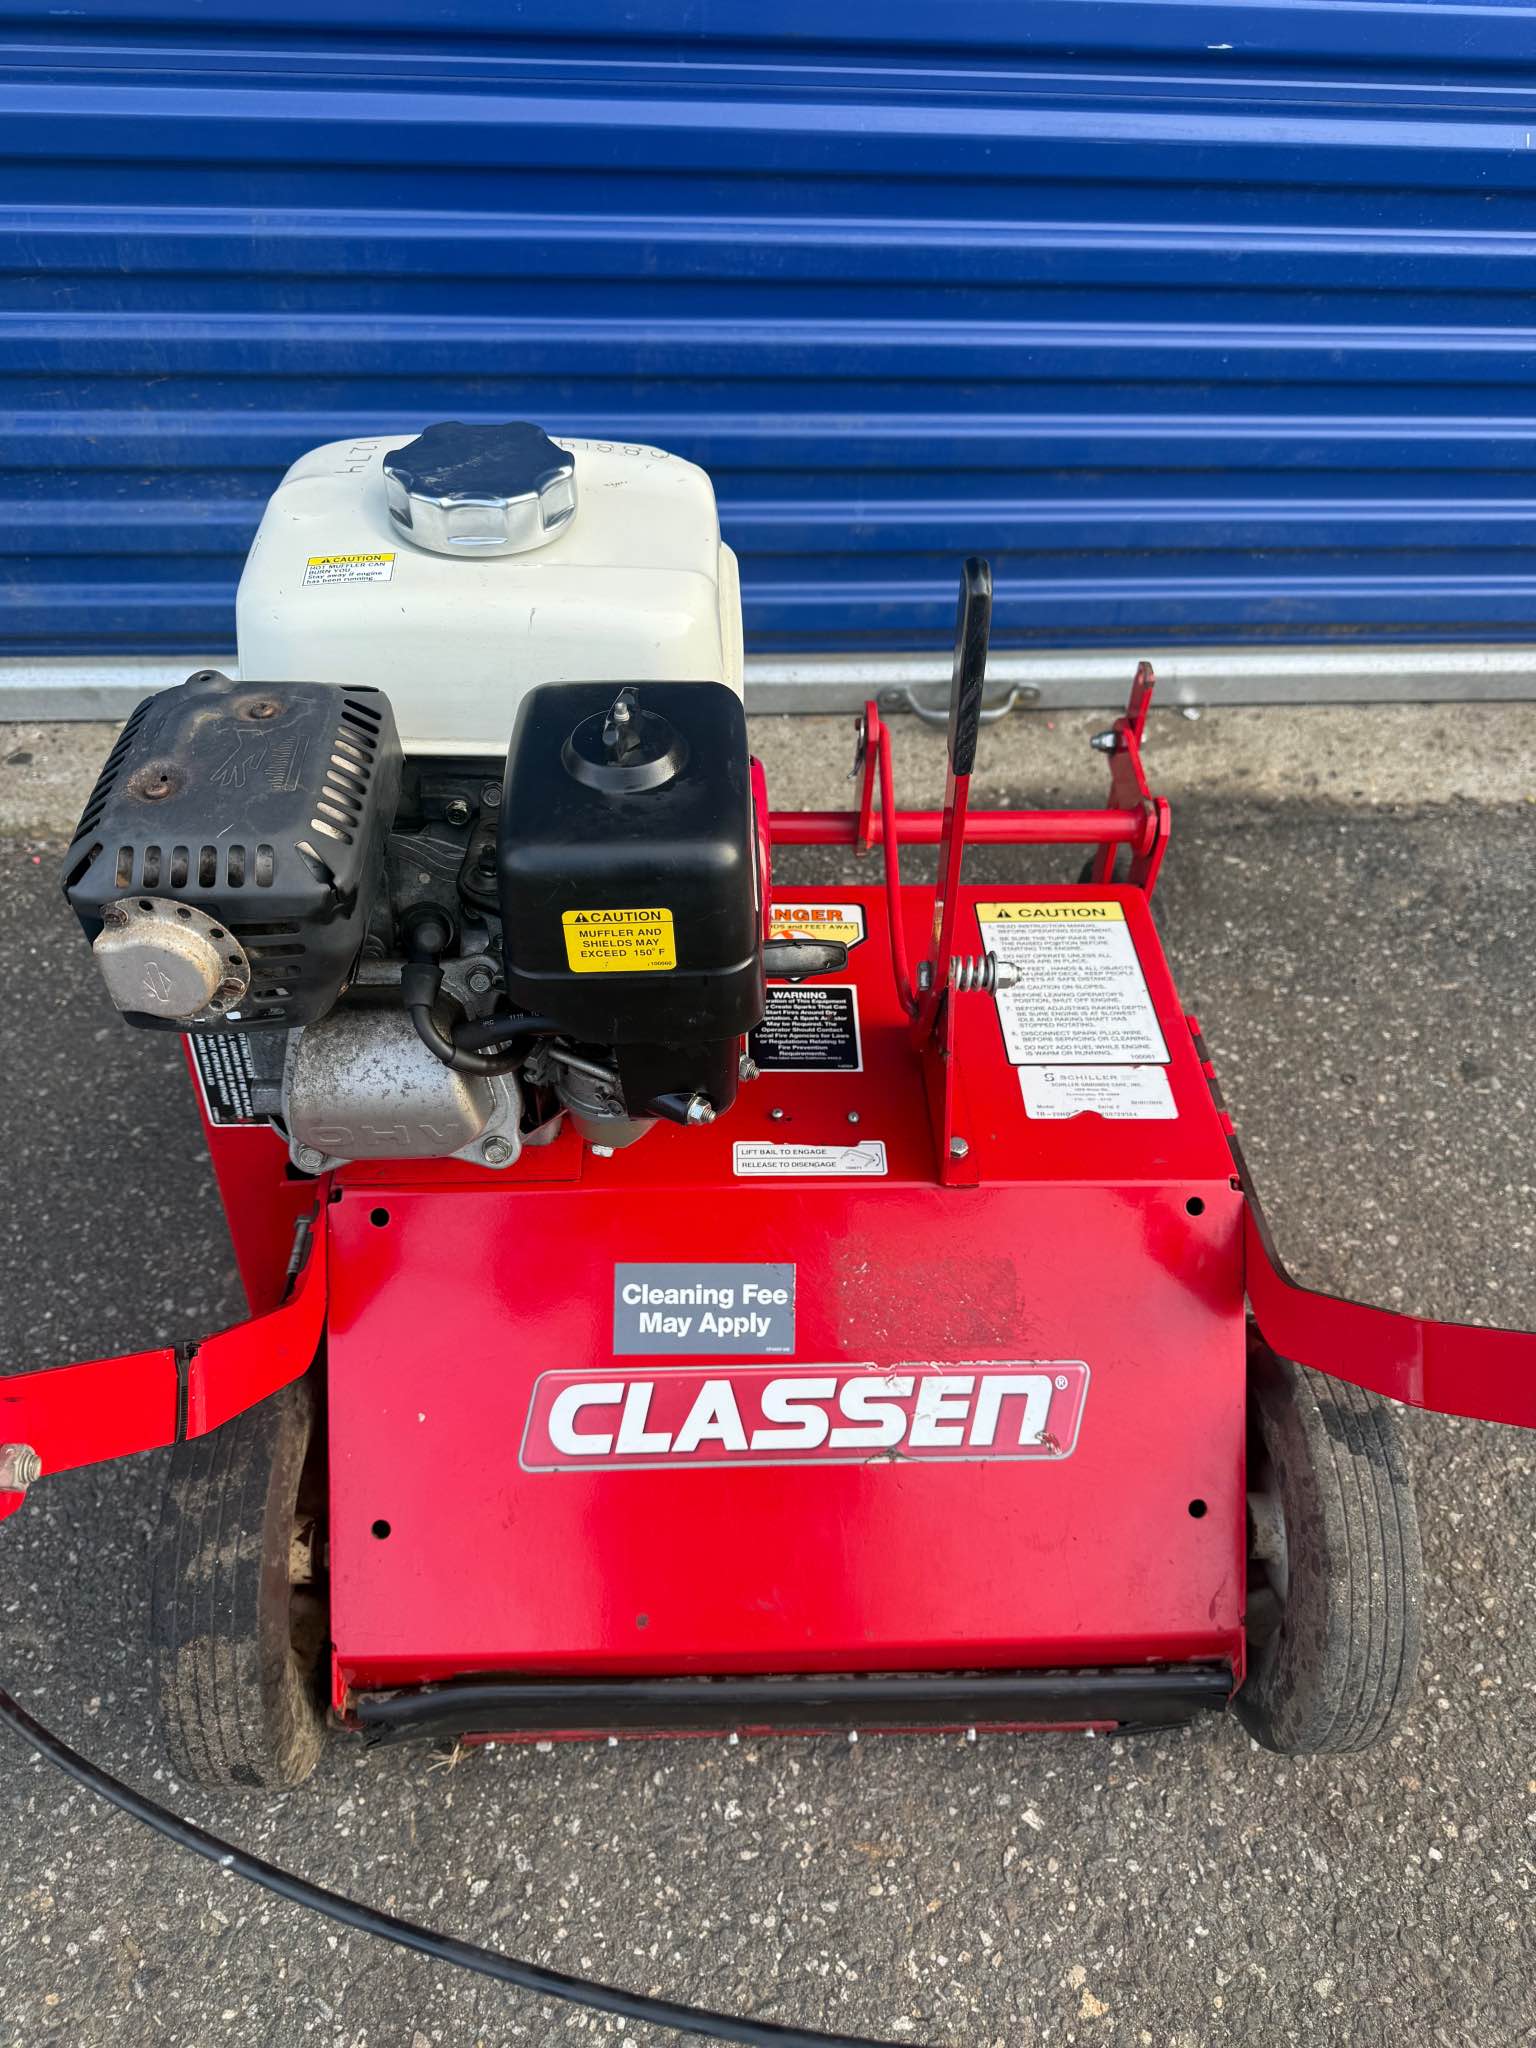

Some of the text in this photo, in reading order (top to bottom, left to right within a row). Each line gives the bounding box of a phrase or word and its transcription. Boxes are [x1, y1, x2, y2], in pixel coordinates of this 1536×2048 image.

[590, 911, 661, 922] CAUTION
[774, 909, 842, 920] NGER
[1017, 908, 1106, 917] CAUTION
[578, 929, 633, 937] MUFFLER
[582, 938, 659, 947] SHIELDS MAY
[580, 949, 626, 957] EXCEED
[307, 1125, 458, 1145] OHV
[621, 1283, 789, 1308] Cleaning Fee
[638, 1313, 771, 1338] May Apply
[547, 1375, 1054, 1455] CLASSEN
